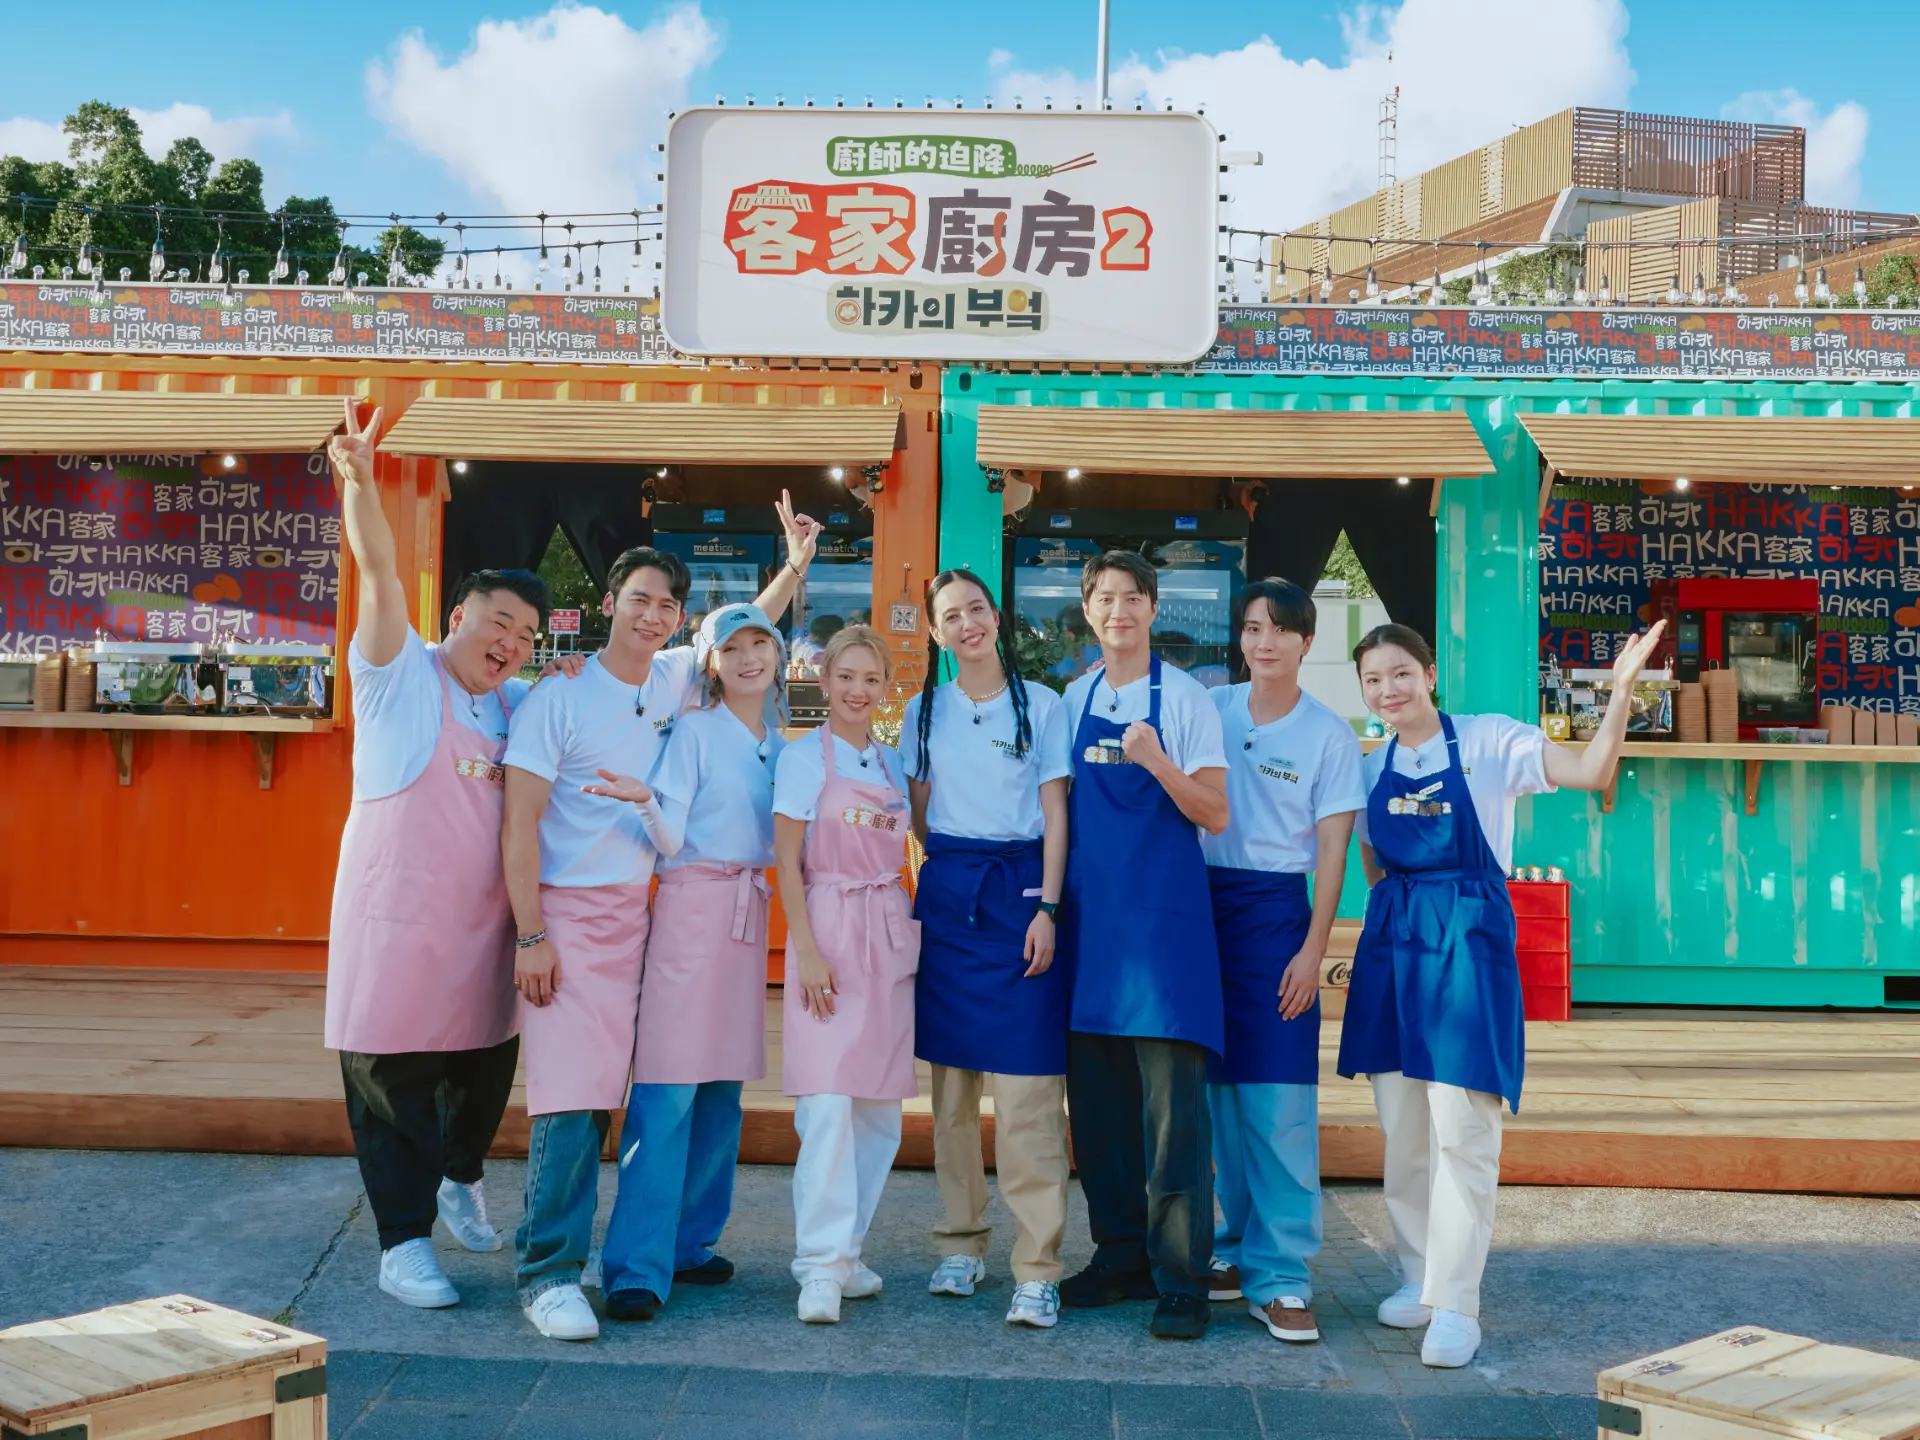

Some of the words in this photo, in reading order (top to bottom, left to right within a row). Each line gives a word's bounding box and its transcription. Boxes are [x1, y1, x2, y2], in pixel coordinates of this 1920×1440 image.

[462, 296, 506, 308] HAKKA
[594, 298, 637, 311] HAKKA
[834, 286, 955, 330] 하카의
[966, 287, 1043, 331] 부엌
[16, 302, 88, 324] HAKKA
[89, 308, 110, 323] 客家
[148, 304, 219, 326] HAKKA
[221, 311, 242, 326] 客家
[279, 307, 350, 329] HAKKA
[352, 314, 373, 328] 客家
[411, 310, 482, 332] HAKKA
[484, 316, 505, 332] 客家
[543, 313, 614, 335] HAKKA
[616, 319, 637, 334] 客家
[1234, 310, 1276, 321] HAKKA
[1367, 311, 1409, 323] HAKKA
[1500, 313, 1542, 324] HAKKA
[1634, 314, 1676, 326] HAKKA
[1769, 316, 1811, 327] HAKKA
[45, 322, 70, 337] 客家
[114, 322, 174, 340] HAKKA
[176, 325, 201, 340] 客家
[245, 325, 305, 342] HAKKA
[308, 328, 333, 343] 客家
[377, 328, 437, 345] HAKKA
[440, 331, 464, 346] 客家
[509, 331, 569, 348] HAKKA
[571, 334, 596, 349] 客家
[1254, 330, 1276, 344] 客家
[1314, 326, 1386, 346] HAKKA
[1388, 332, 1408, 346] 客家
[1447, 328, 1520, 348] HAKKA
[1521, 334, 1542, 348] 客家
[1581, 329, 1653, 349] HAKKA
[1655, 335, 1676, 350] 客家
[1716, 330, 1788, 350] HAKKA
[1790, 336, 1811, 351] 客家
[1280, 343, 1341, 361] HAKKA
[1342, 347, 1368, 361] 客家
[1413, 345, 1474, 362] HAKKA
[1476, 348, 1502, 362] 客家
[1547, 346, 1608, 364] HAKKA
[1610, 350, 1636, 364] 客家
[1682, 348, 1742, 366] HAKKA
[1745, 352, 1770, 366] 客家
[1816, 349, 1877, 366] HAKKA
[1880, 352, 1905, 366] 客家
[14, 471, 150, 511] HAKKA
[154, 483, 194, 512] 客家
[198, 476, 260, 508] 하카
[69, 512, 116, 540] 客家
[201, 510, 316, 544] HAKKA
[1593, 504, 1634, 532] 客家
[1639, 496, 1702, 528] 하카
[1708, 495, 1848, 535] HAKKA
[1850, 506, 1890, 536] 客家
[102, 544, 196, 566] HAKKA
[200, 542, 252, 568] 客家
[694, 543, 734, 552] meatico
[1642, 529, 1760, 564] HAKKA
[1764, 535, 1814, 564] 客家
[49, 566, 108, 598] 하카
[109, 570, 188, 594] HAKKA
[242, 570, 298, 606] 客家
[1543, 564, 1638, 586] HAKKA
[1550, 592, 1632, 614] HAKKA
[147, 610, 186, 638] 客家
[1849, 634, 1890, 664] 客家
